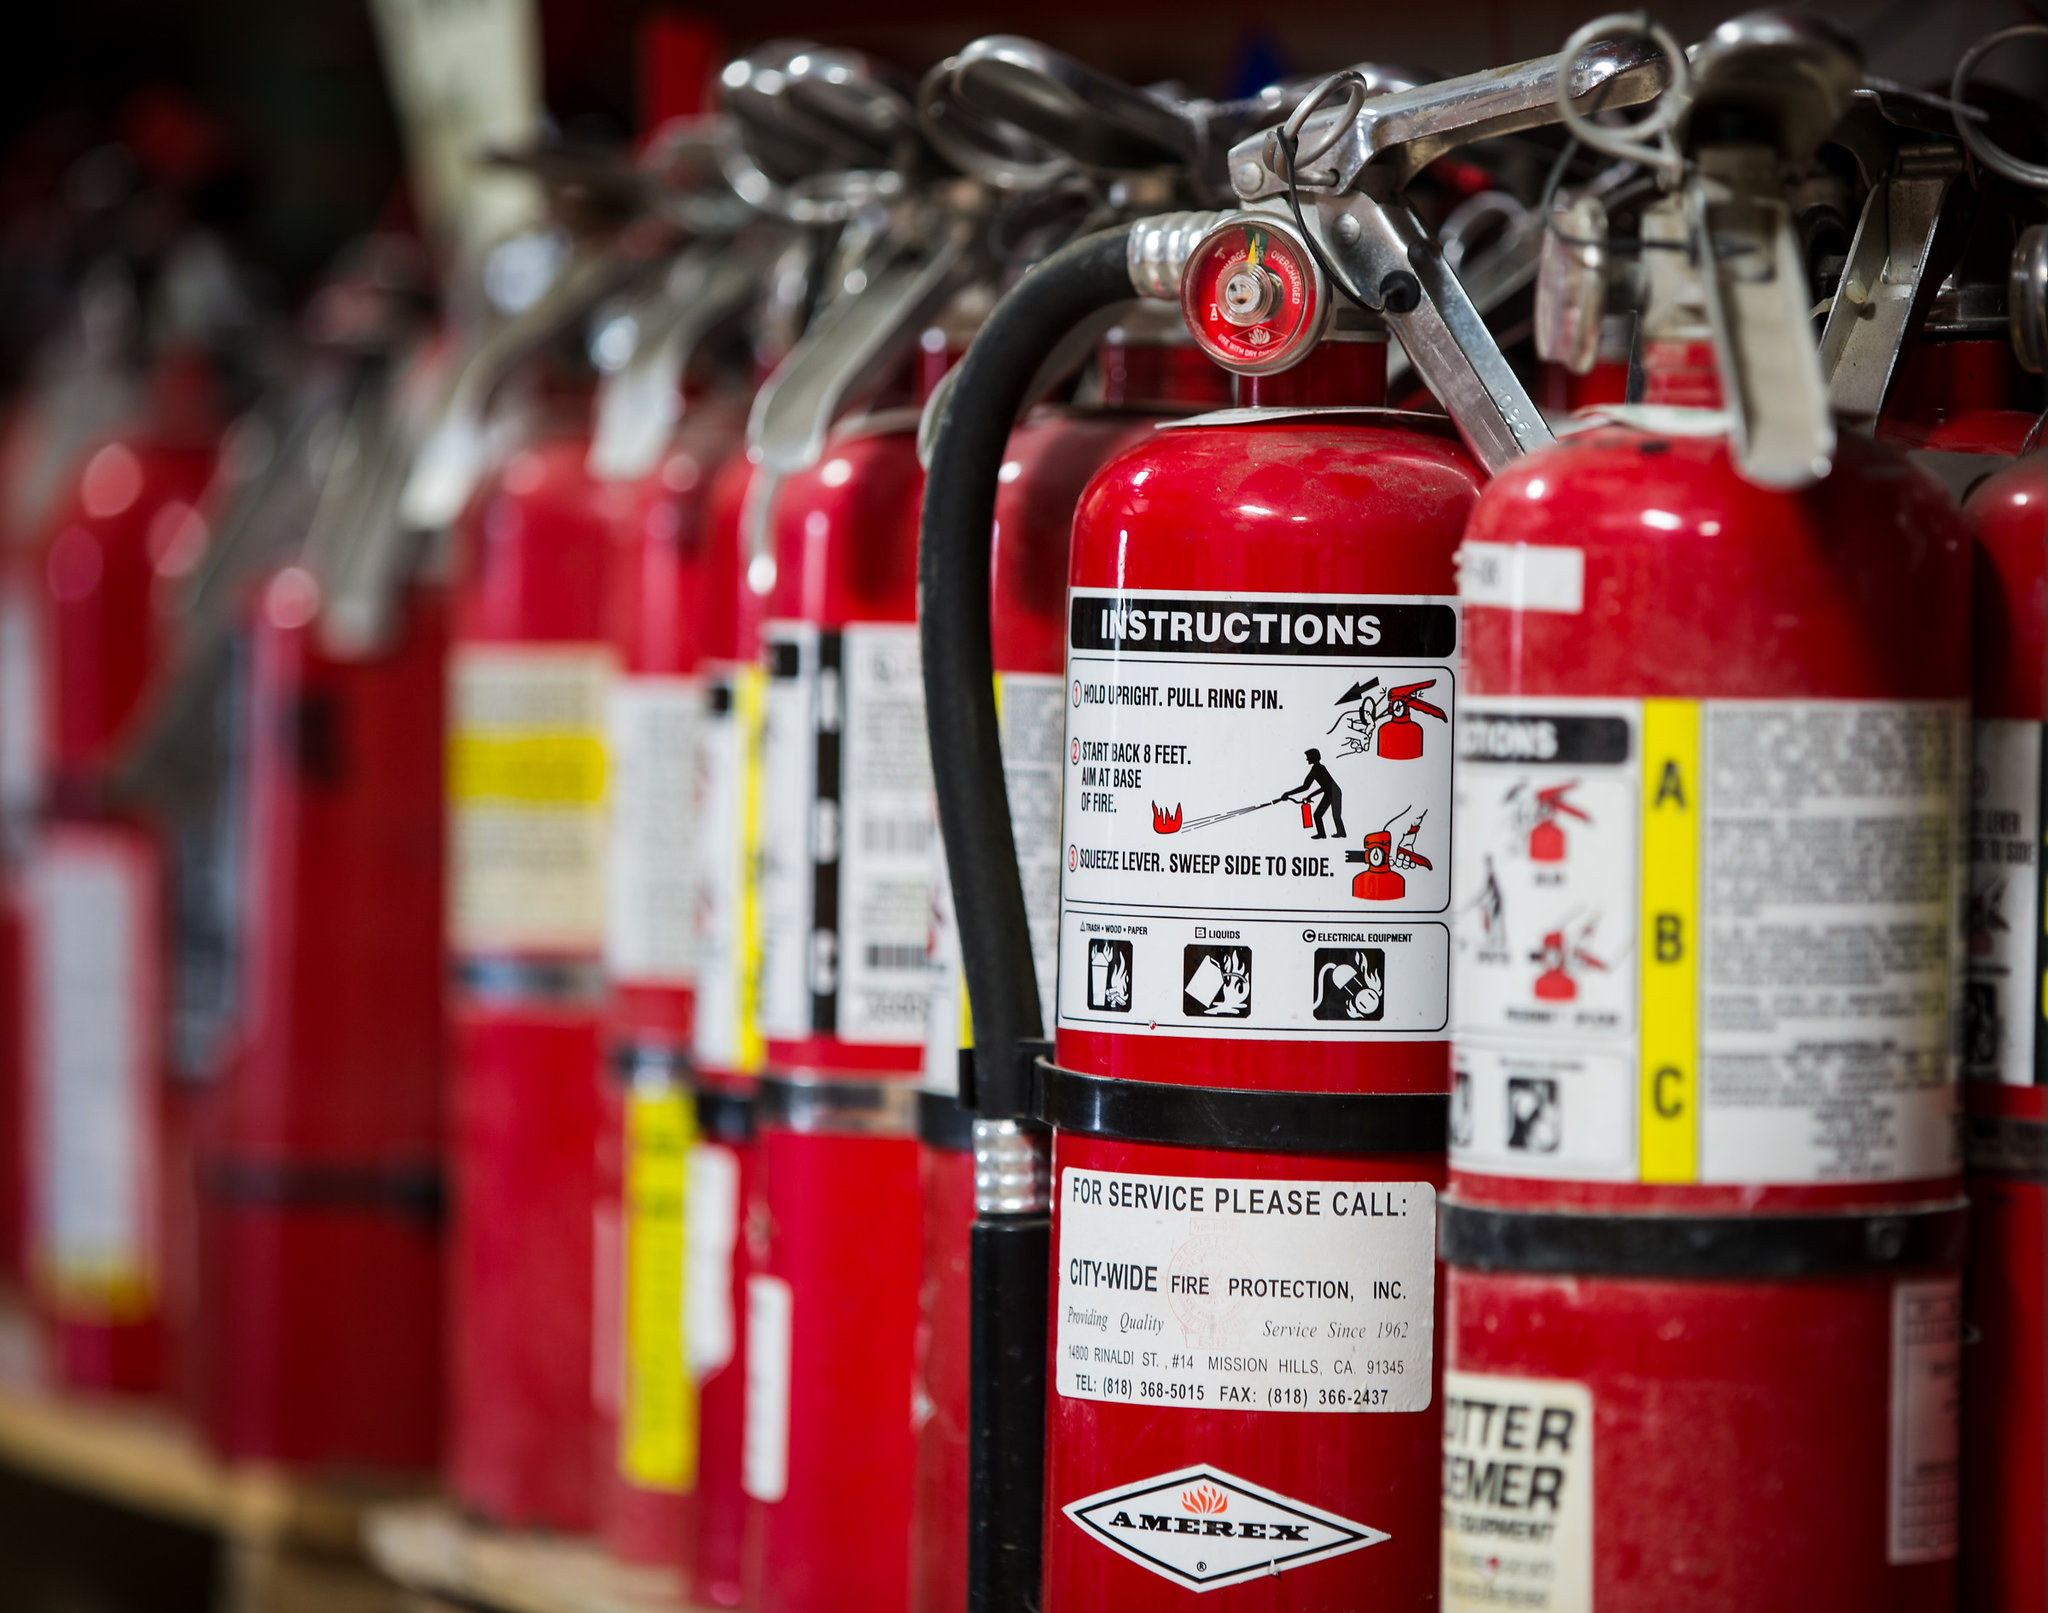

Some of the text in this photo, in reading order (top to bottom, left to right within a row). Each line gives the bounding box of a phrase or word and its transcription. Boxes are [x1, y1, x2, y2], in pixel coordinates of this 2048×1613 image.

[1270, 249, 1302, 305] OVERCHARGED
[1100, 609, 1382, 645] INSTRUCTIONS
[1083, 683, 1106, 705] HOLD
[1108, 684, 1163, 707] UPRIGHT.
[1167, 686, 1204, 708] PULL
[1207, 688, 1246, 710] RING
[1250, 689, 1284, 710] PIN.
[1082, 740, 1110, 762] START
[1111, 742, 1141, 764] BACK
[1143, 743, 1151, 764] 8
[1154, 744, 1192, 765] FEET.
[1081, 766, 1142, 789] AIM AT BASE
[1653, 761, 1688, 813] A
[1081, 791, 1117, 814] OF FIRE.
[1079, 848, 1120, 870] SQUEEZE
[1122, 850, 1165, 873] LEVER.
[1169, 852, 1221, 875] SWEEP
[1224, 854, 1262, 876] SIDE
[1265, 855, 1287, 877] TO
[1291, 856, 1335, 878] SIDE.
[1085, 922, 1101, 933] TRASH
[1104, 924, 1122, 934] WOOD
[1127, 925, 1148, 936] PAPER
[1208, 929, 1241, 940] LIQUIDS
[1317, 932, 1366, 943] ELECTRICAL
[1367, 933, 1413, 943] EQUIPMENT
[1654, 915, 1685, 963] B
[1653, 1069, 1685, 1119] C
[1072, 1176, 1407, 1217] FOR SERVICE PLEASE CALL:
[1070, 1257, 1407, 1303] CITY-WIDE FIRE PROTECTION, INC.
[1067, 1305, 1409, 1339] Providing Quality Service Since 1962
[1094, 1346, 1134, 1366] RINALDI
[1172, 1353, 1194, 1369] #14
[1208, 1355, 1268, 1373] MISSION
[1278, 1359, 1323, 1376] HILLS,
[1367, 1359, 1405, 1375] 91345
[1075, 1373, 1389, 1409] TEL: (818) 368-5015 FAX: (818) 366-2437
[1108, 1510, 1310, 1542] AMEREX
